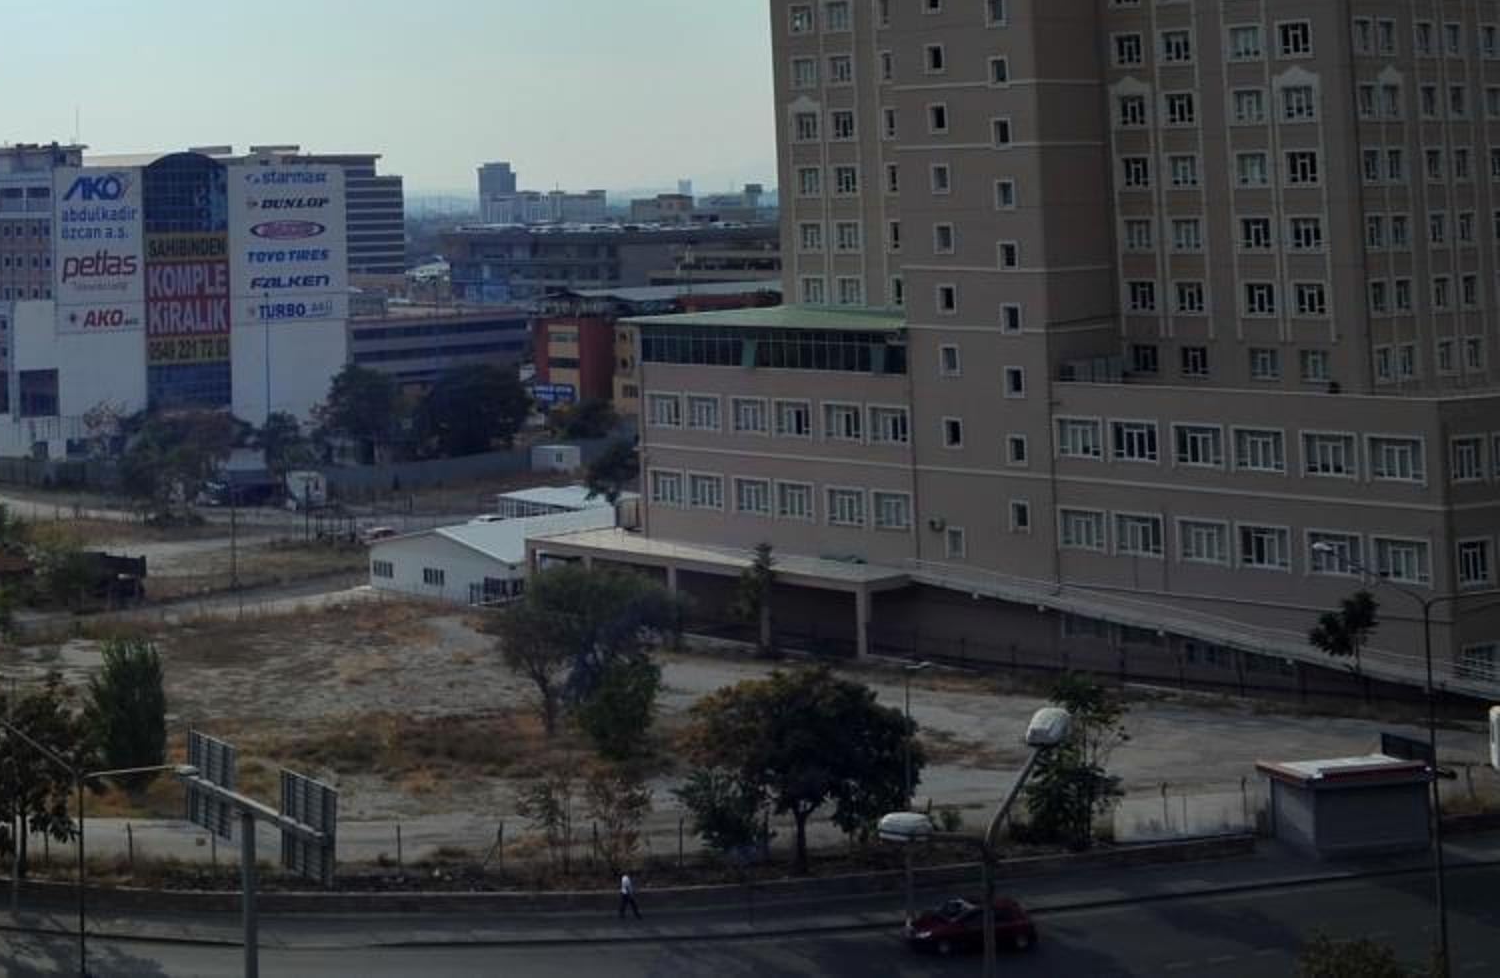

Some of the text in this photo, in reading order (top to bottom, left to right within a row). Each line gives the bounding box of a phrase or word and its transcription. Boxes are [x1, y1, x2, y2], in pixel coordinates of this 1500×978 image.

[62, 175, 122, 201] AKO
[261, 197, 330, 209] DUNLOP
[247, 249, 330, 263] TOYO TIRES
[62, 249, 138, 284] petlas
[148, 263, 228, 297] KOMPLE
[250, 275, 330, 290] FALKEN
[83, 309, 124, 327] AKO
[259, 303, 306, 319] TURBO
